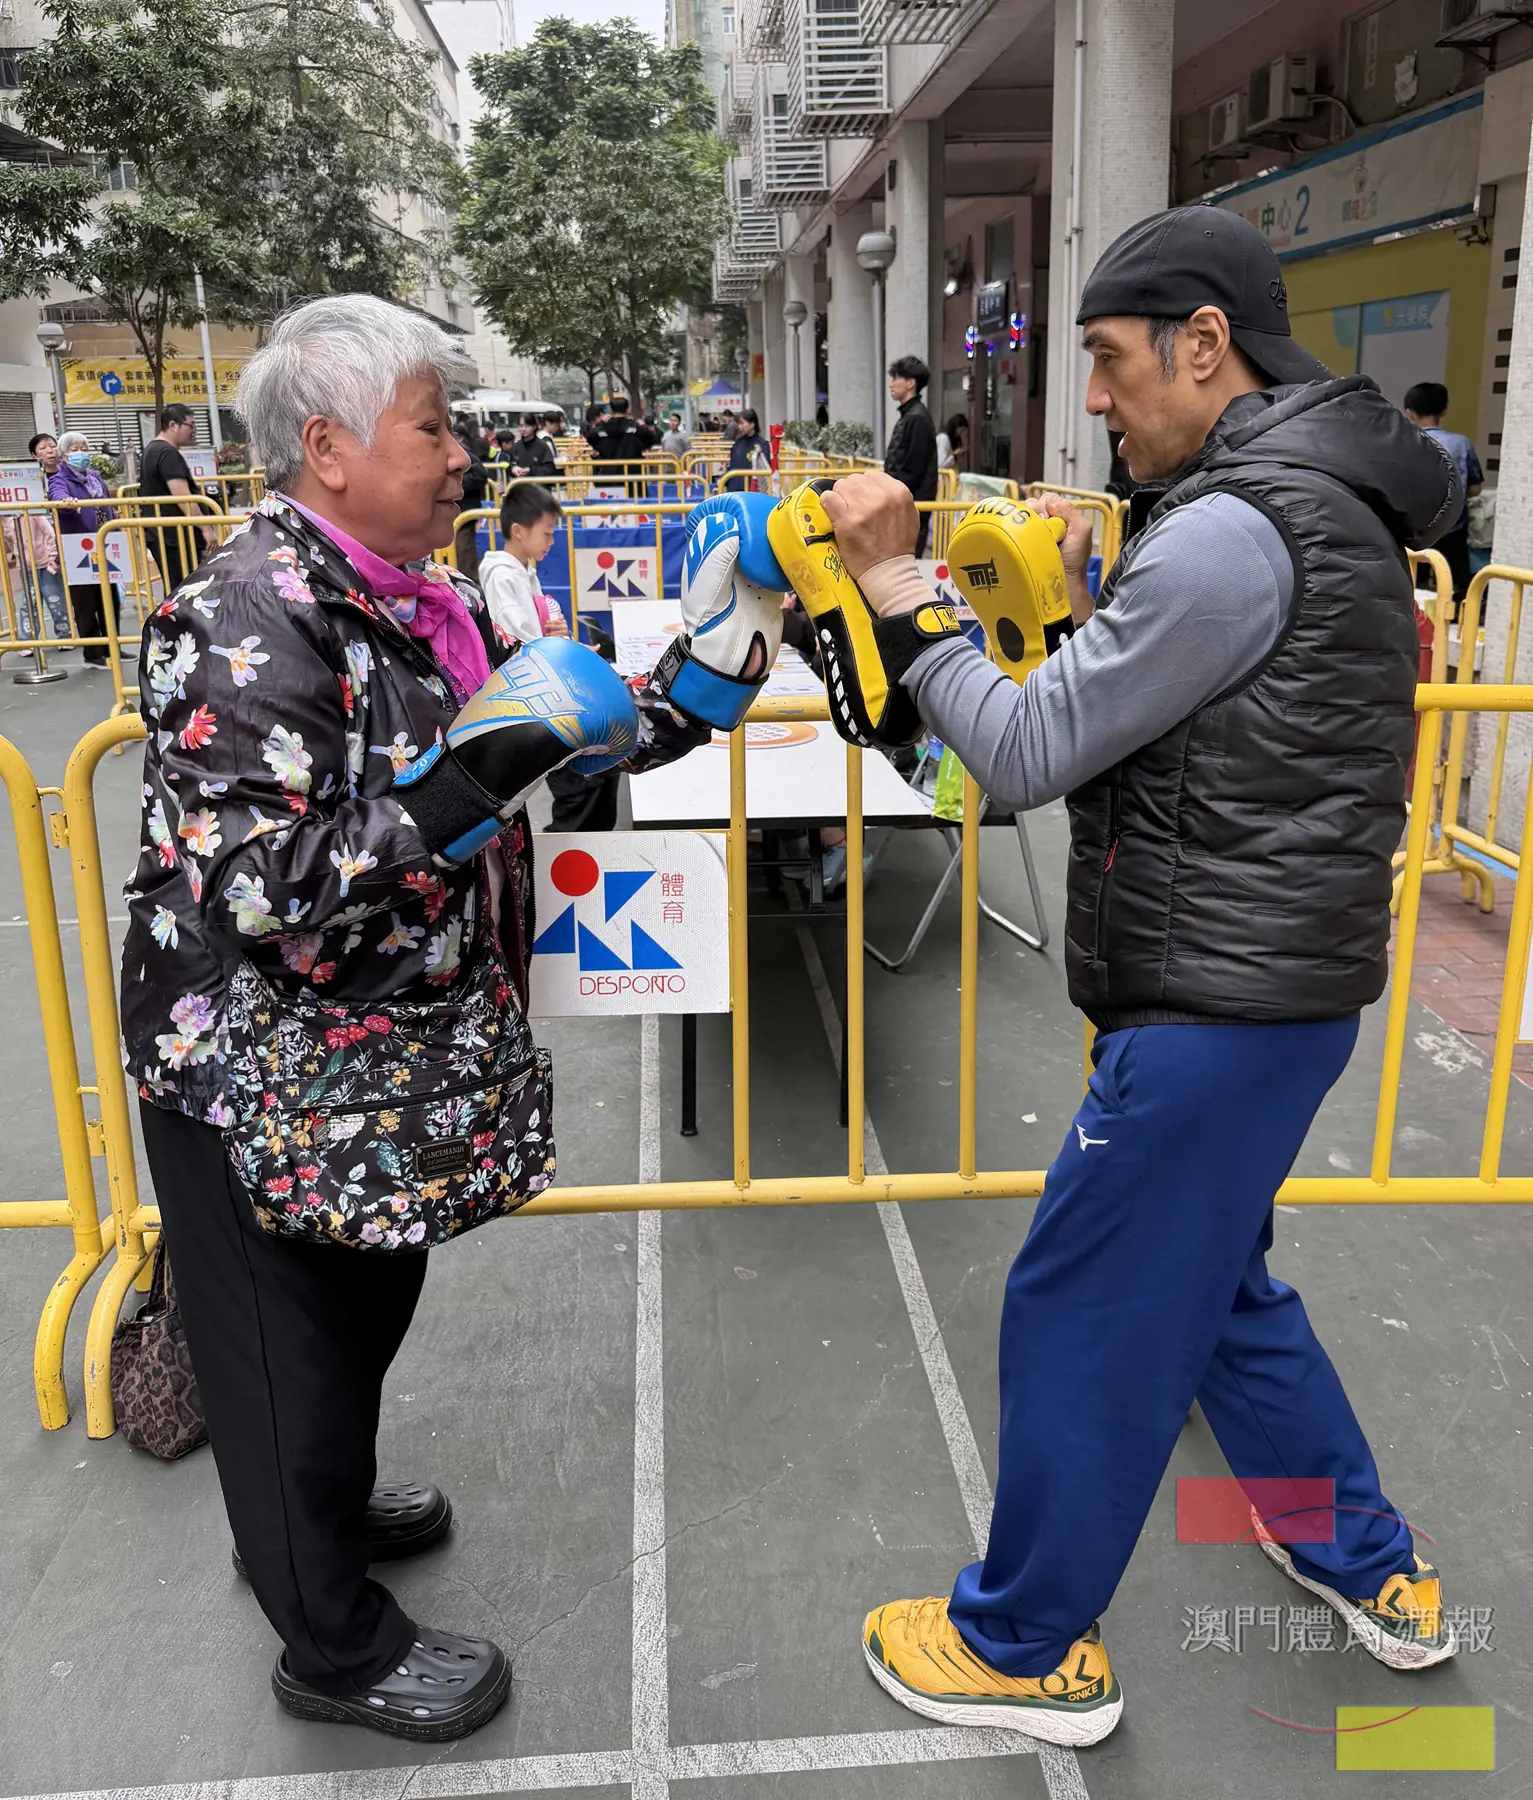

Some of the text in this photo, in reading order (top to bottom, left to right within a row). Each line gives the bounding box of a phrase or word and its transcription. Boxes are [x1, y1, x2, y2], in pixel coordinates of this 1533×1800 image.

[0, 487, 29, 502] 出口
[660, 872, 686, 929] 體育
[579, 974, 687, 996] DESPORTO
[1067, 1683, 1099, 1702] ONKE
